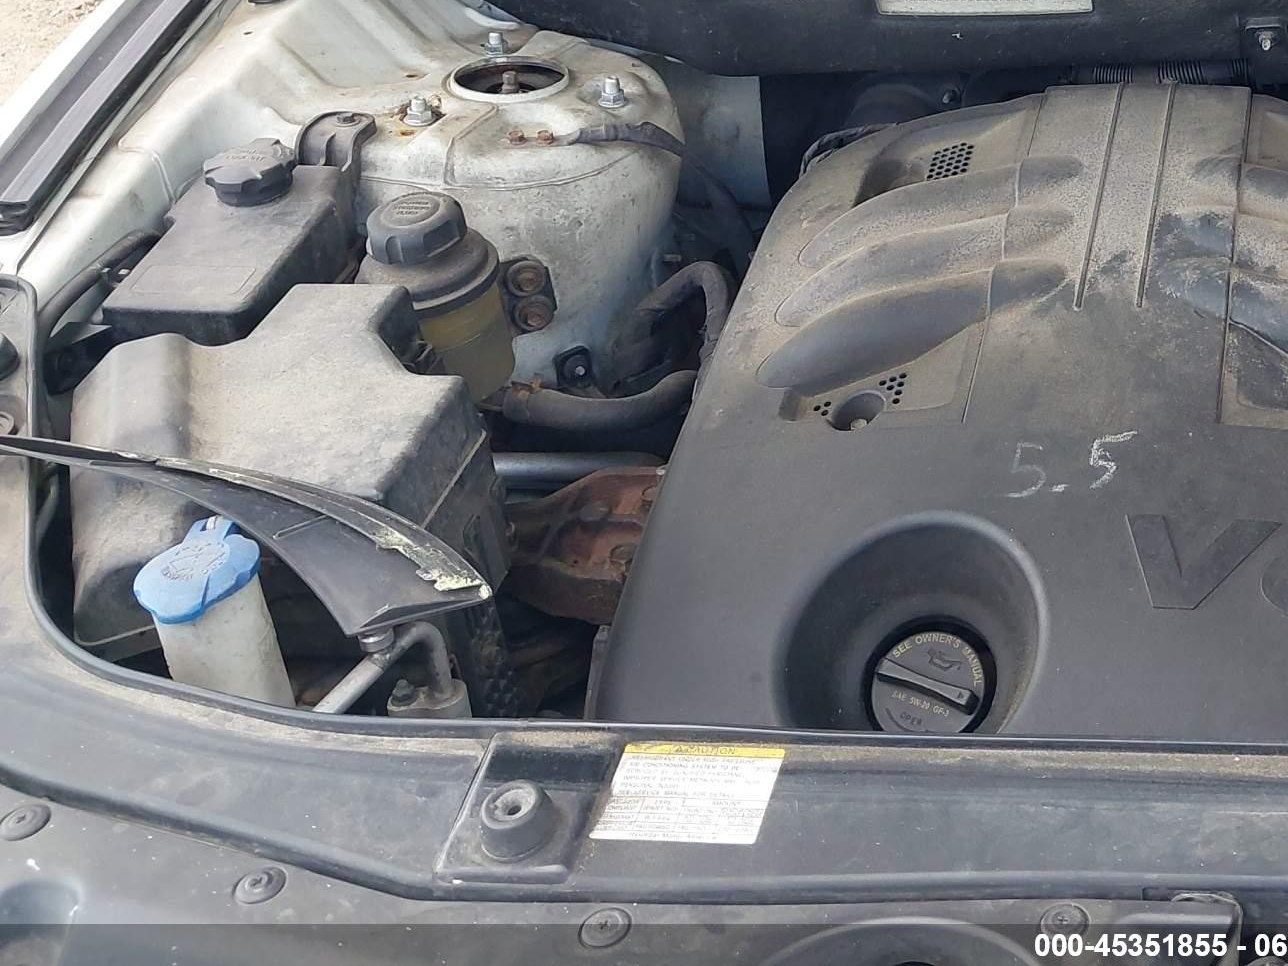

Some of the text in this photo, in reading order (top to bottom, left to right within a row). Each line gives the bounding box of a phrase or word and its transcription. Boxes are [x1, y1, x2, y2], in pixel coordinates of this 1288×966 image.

[893, 633, 983, 688] SEE OWNER'S MANUAL
[892, 690, 907, 701] SAE
[685, 745, 735, 754] CAUTION
